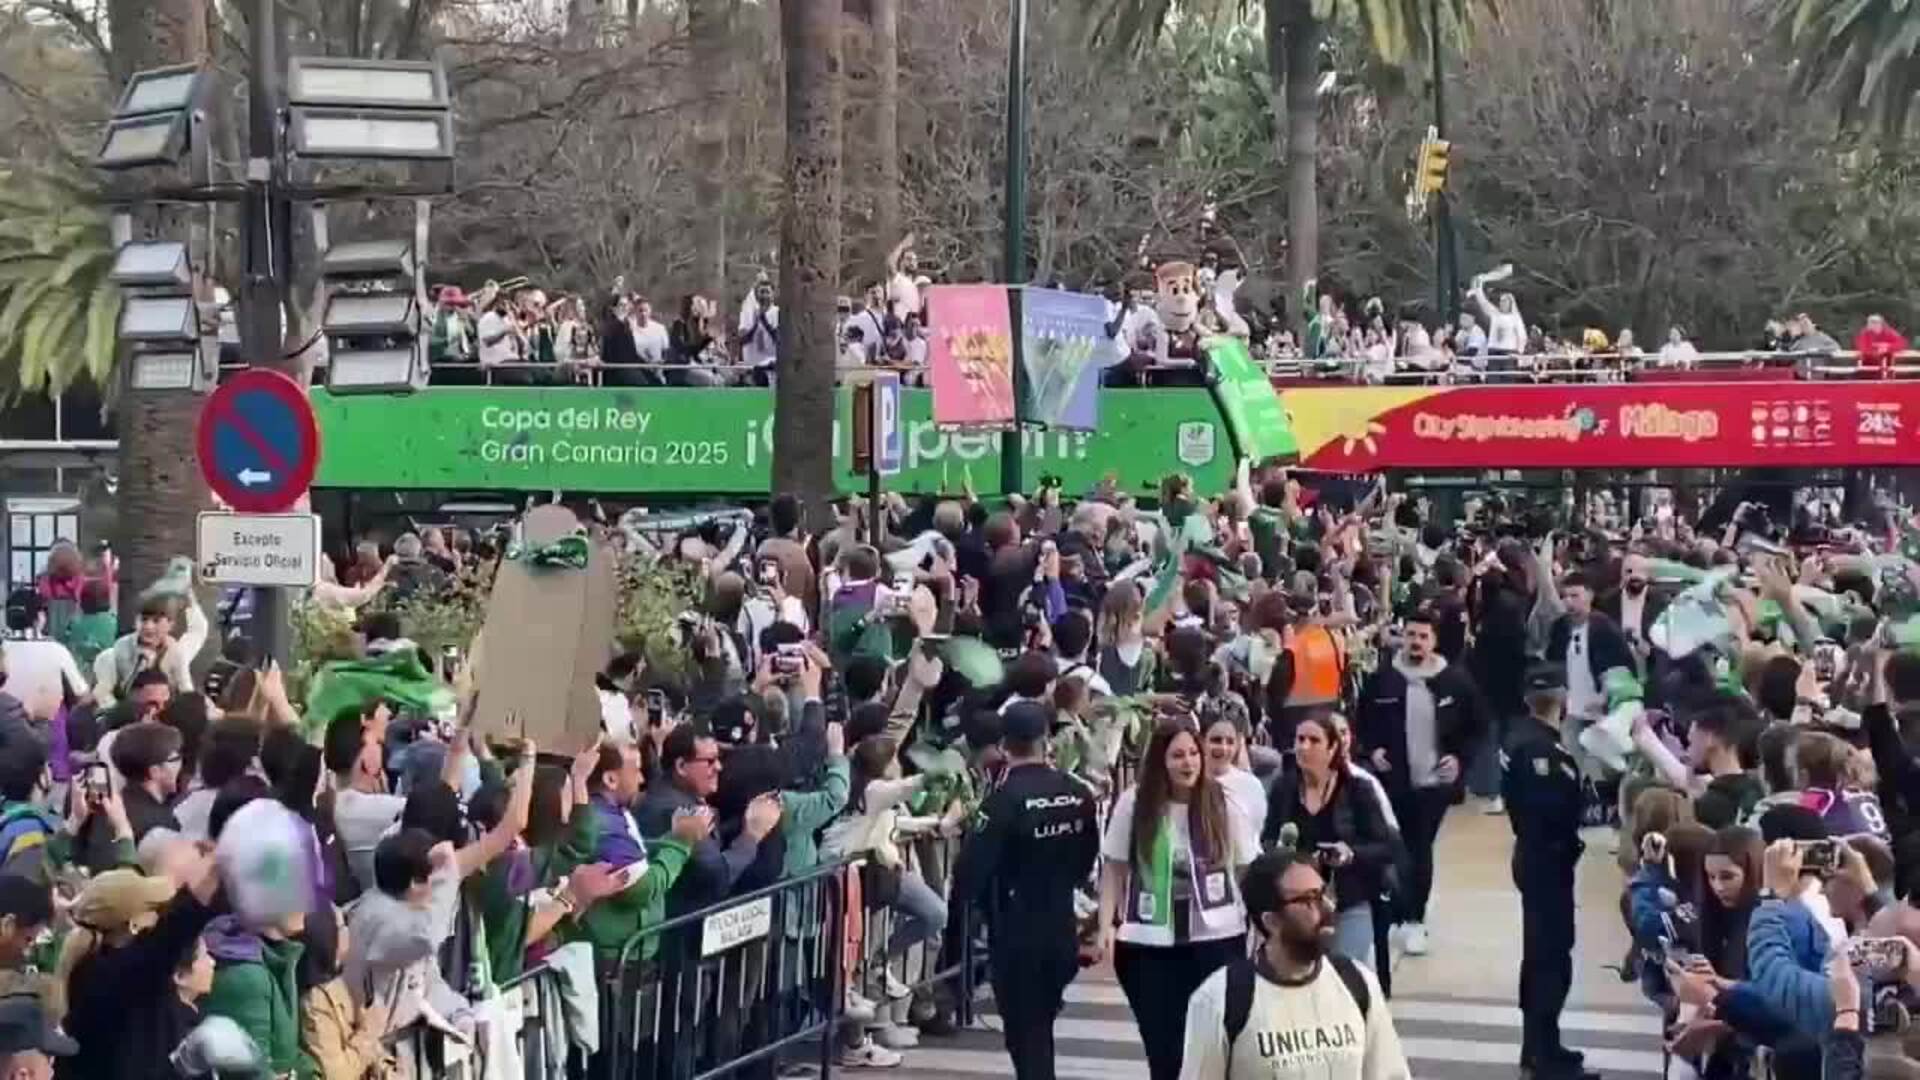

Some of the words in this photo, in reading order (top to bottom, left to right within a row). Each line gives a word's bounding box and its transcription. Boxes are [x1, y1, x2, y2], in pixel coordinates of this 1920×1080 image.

[481, 406, 550, 432] Copa
[557, 407, 599, 430] del
[605, 407, 652, 433] Rey
[881, 384, 896, 460] P
[480, 439, 544, 463] Gran
[551, 439, 658, 464] Canaria
[664, 441, 729, 465] 2025
[232, 530, 282, 547] Excepto
[214, 552, 260, 568] Servicio
[263, 553, 303, 569] Oficial
[1860, 801, 1886, 834] 9
[1257, 1022, 1357, 1058] UNICAJA
